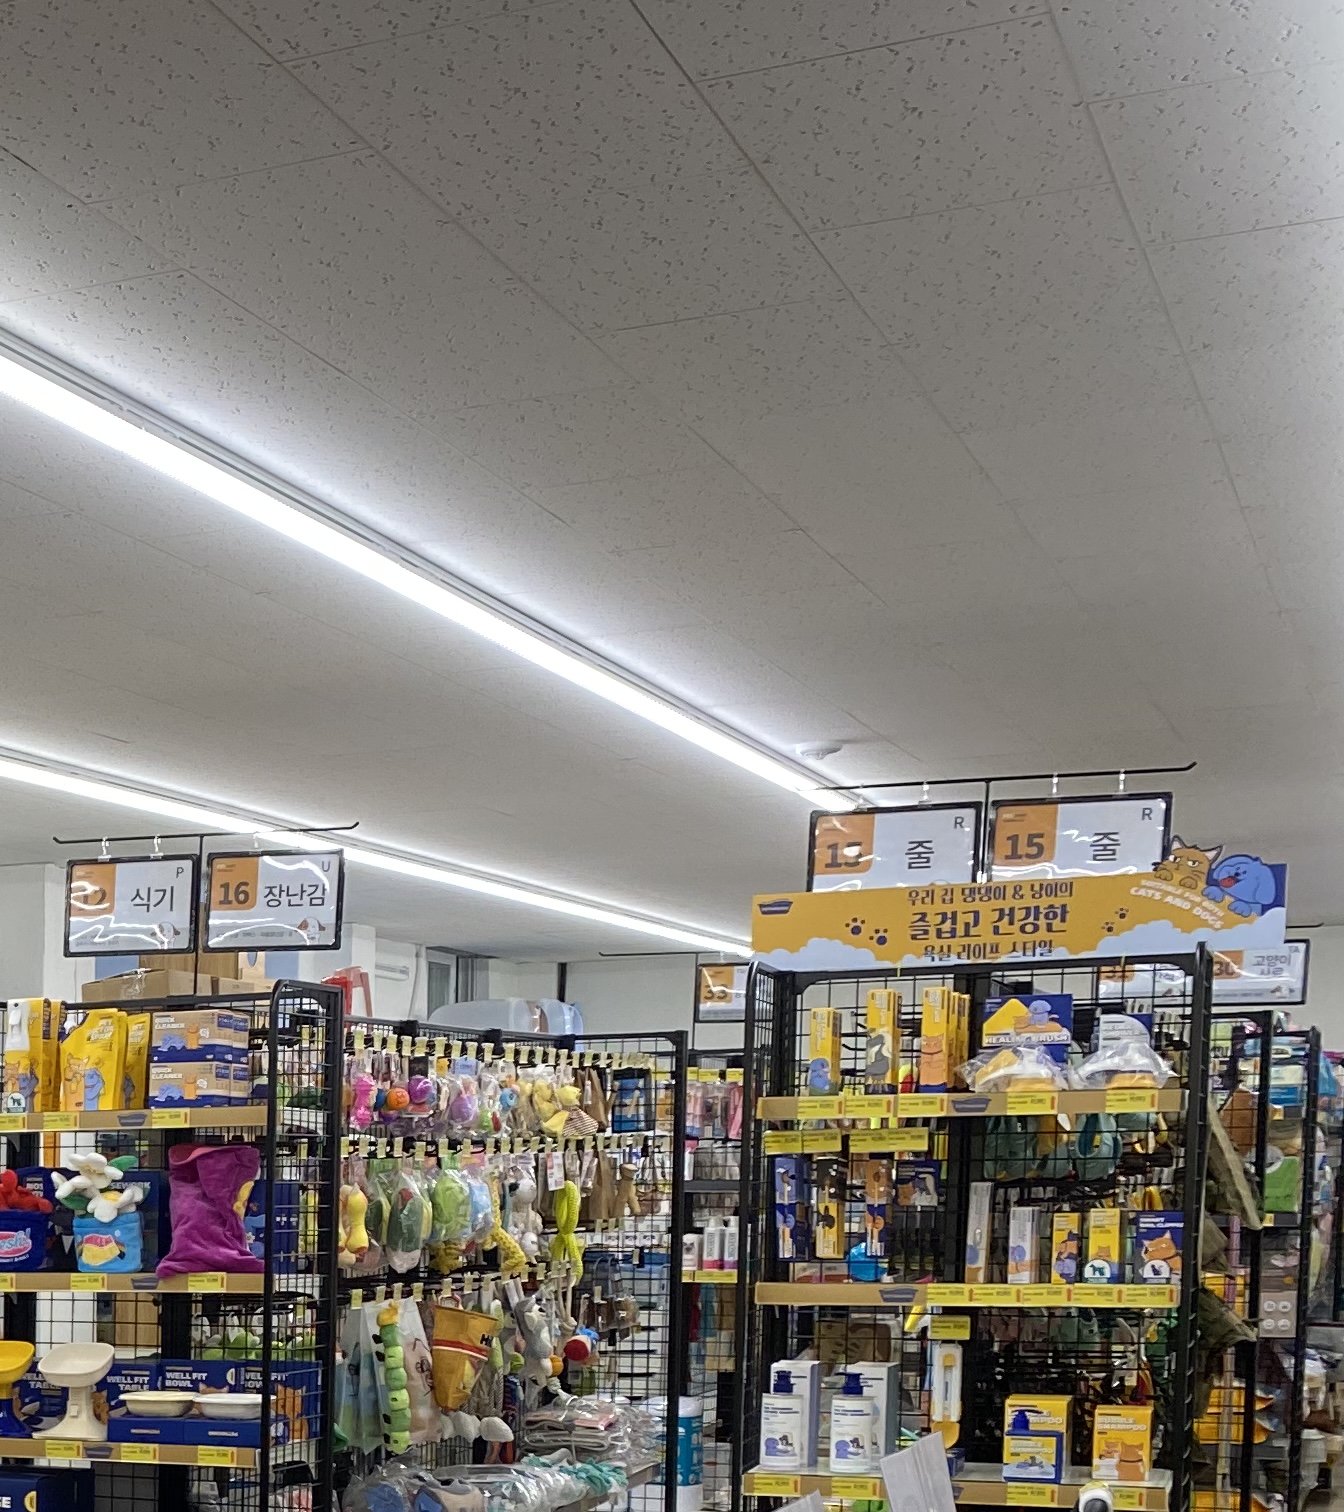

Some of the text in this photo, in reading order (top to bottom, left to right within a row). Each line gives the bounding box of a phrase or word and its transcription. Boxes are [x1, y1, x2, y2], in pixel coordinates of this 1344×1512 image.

[953, 815, 965, 830] R
[1141, 807, 1153, 822] R
[904, 838, 936, 871] 줄
[1003, 831, 1046, 861] 15
[1089, 829, 1122, 862] 줄
[175, 866, 185, 879] P
[130, 885, 175, 912] 식기
[218, 880, 251, 907] 16
[263, 884, 328, 909] 장난감
[907, 880, 1075, 907] 우리 집 댕댕이 & 냥이의
[1129, 886, 1225, 930] CATS AND DOGS
[908, 903, 1070, 942] 즐겁고 건강한
[923, 939, 1054, 963] 욕실 라이프 스타일
[1252, 953, 1293, 968] 고양이
[1032, 1033, 1071, 1044] BRUSH
[106, 1374, 150, 1385] WELL FIT
[118, 1383, 150, 1392] TABLE
[164, 1379, 194, 1388] BOWL
[165, 1371, 209, 1382] WELL FIT
